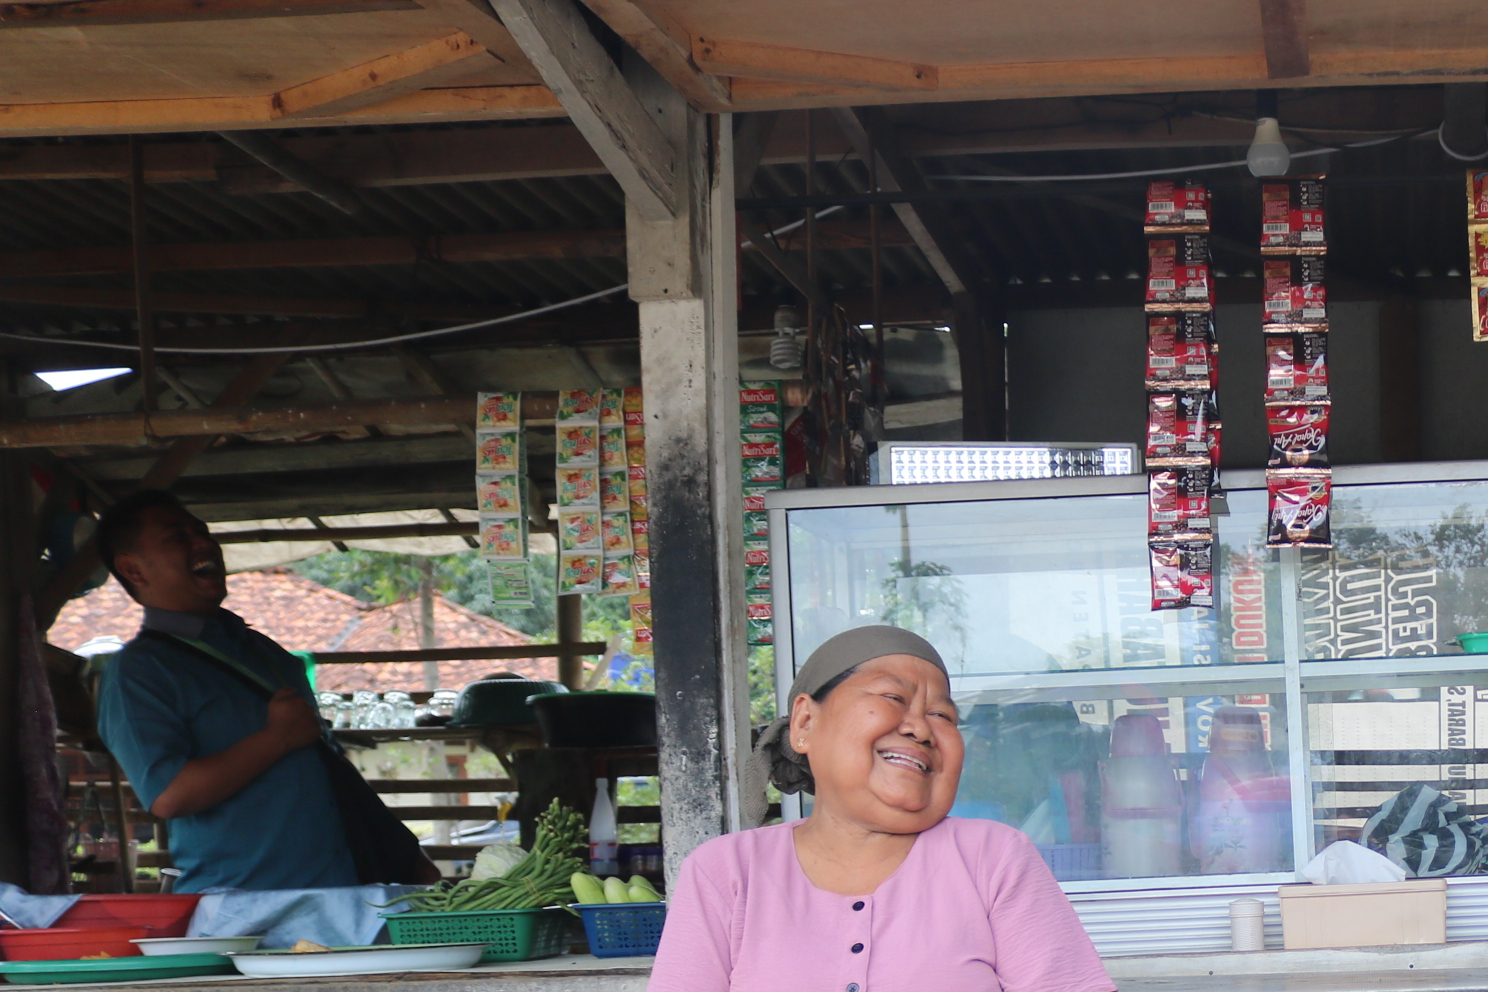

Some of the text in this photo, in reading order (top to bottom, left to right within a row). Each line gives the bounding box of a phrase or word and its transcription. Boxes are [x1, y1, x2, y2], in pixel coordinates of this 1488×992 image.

[740, 390, 776, 402] NutriSari
[1273, 428, 1322, 449] Kapal Api
[742, 444, 778, 457] NutriSari
[744, 498, 766, 511] Nutri
[1272, 503, 1323, 524] Kapal Api
[746, 551, 769, 565] NutriS
[748, 605, 772, 619] NutriS
